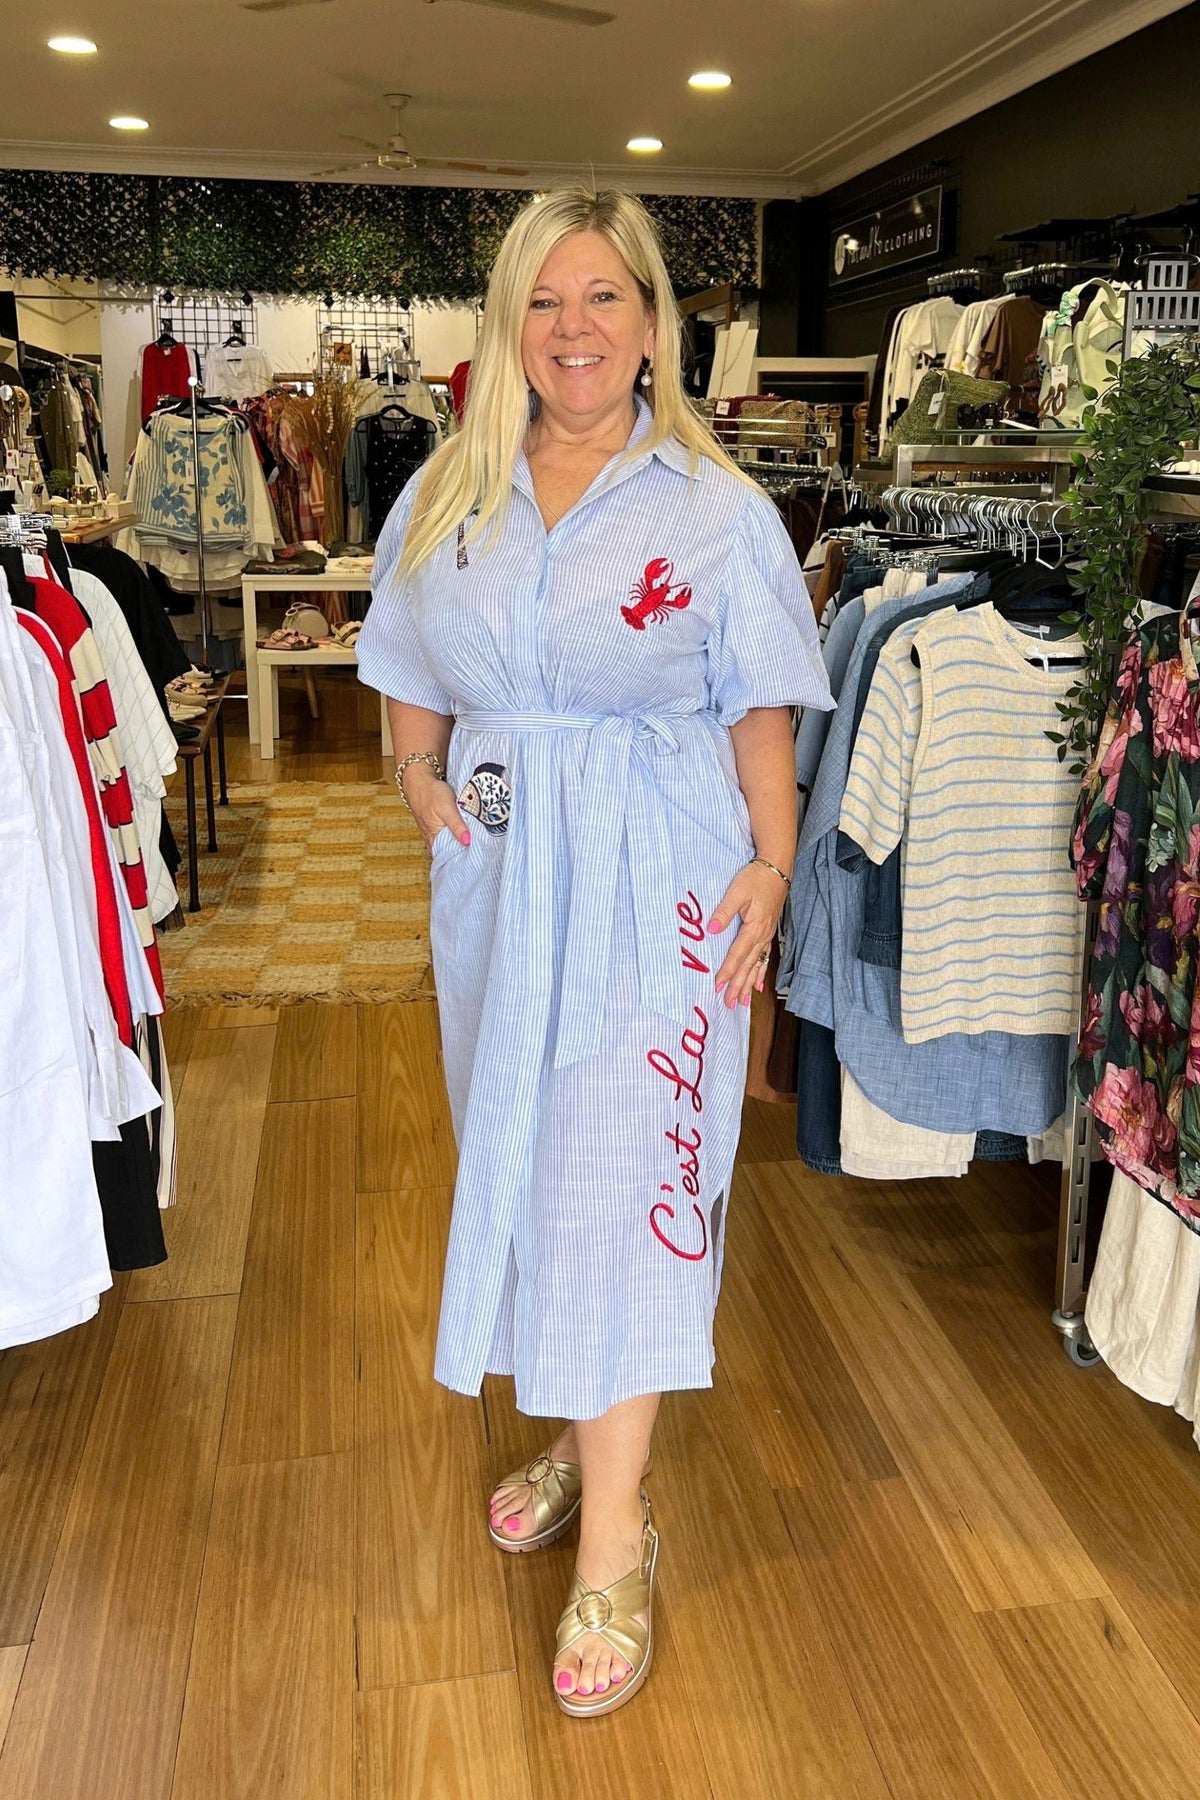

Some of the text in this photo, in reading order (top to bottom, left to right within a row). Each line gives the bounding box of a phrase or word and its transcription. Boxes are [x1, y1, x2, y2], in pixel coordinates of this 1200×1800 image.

[885, 224, 932, 252] CLOTHING
[647, 890, 710, 1261] C'est La vie
